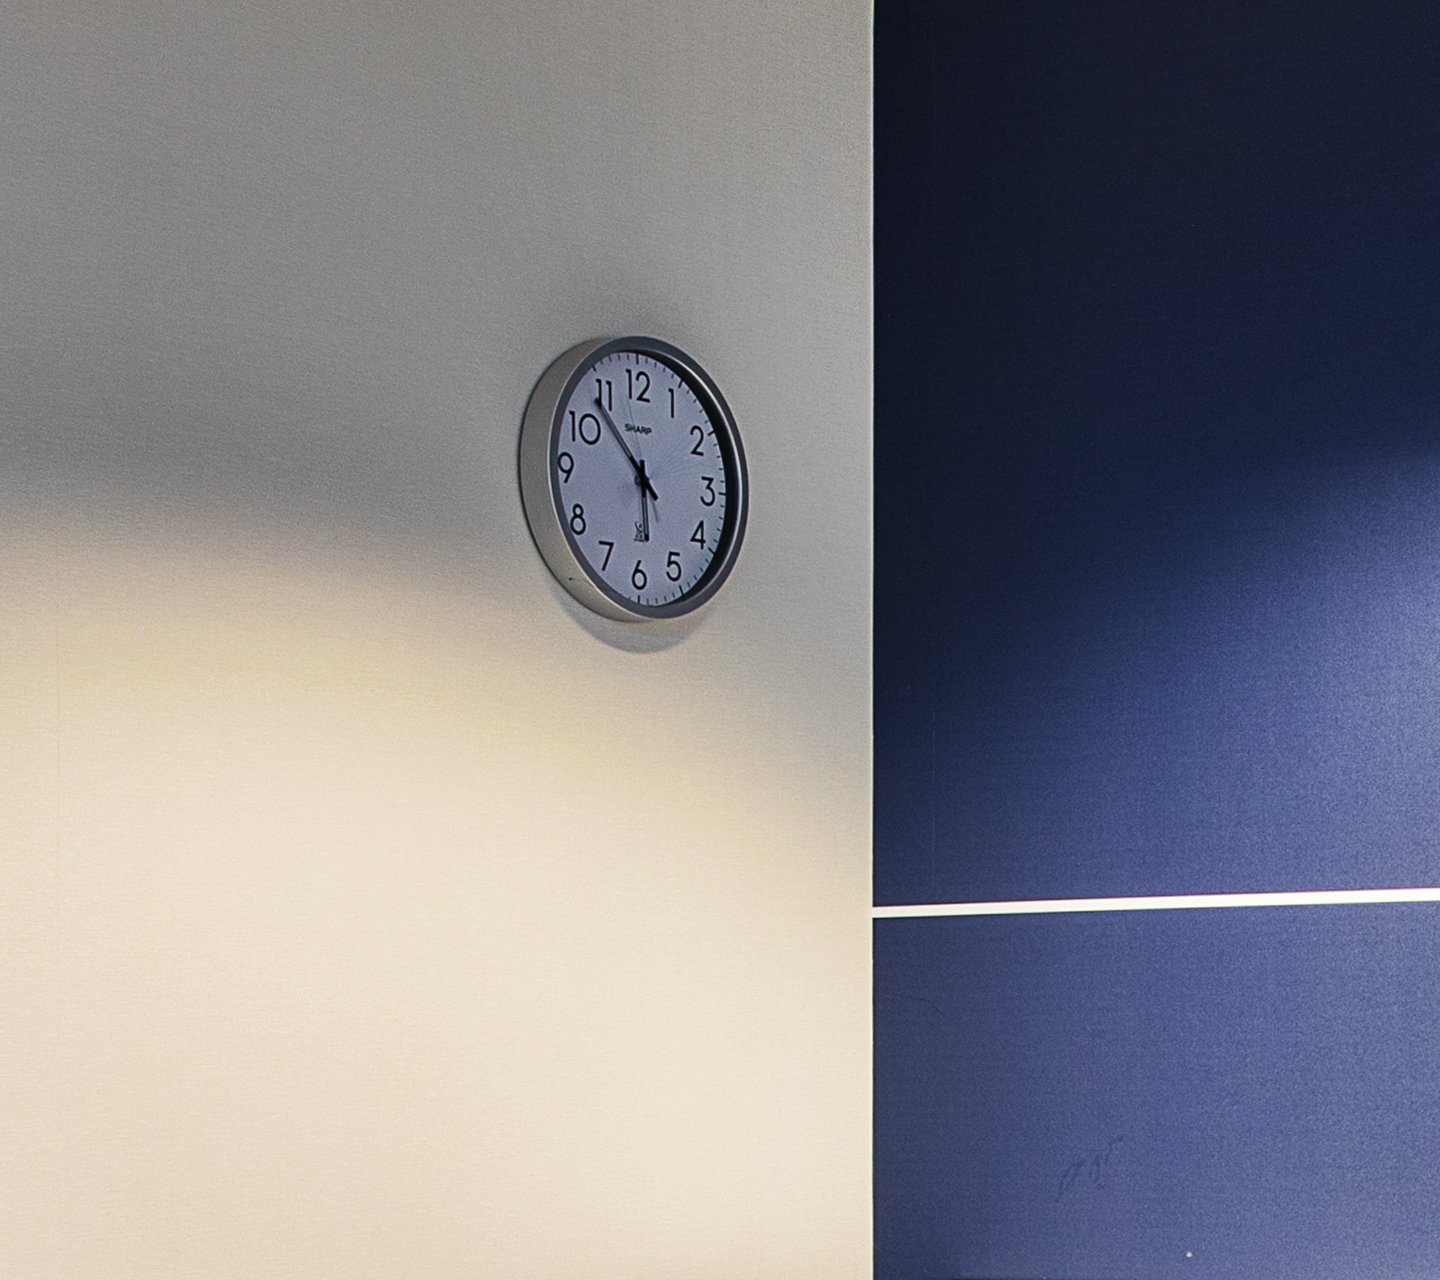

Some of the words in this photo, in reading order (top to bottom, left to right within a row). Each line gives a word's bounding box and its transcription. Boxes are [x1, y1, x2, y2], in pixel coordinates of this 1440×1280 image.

[595, 378, 614, 412] 11
[625, 368, 651, 403] 12
[668, 388, 675, 418] 1
[569, 410, 601, 445] 10
[624, 423, 653, 435] SHARP
[690, 425, 705, 456] 2
[558, 451, 575, 484] 9
[700, 476, 716, 506] 3
[570, 503, 586, 535] 8
[689, 520, 707, 550] 4
[598, 540, 615, 571] 7
[665, 551, 682, 582] 5
[632, 559, 647, 590] 6
